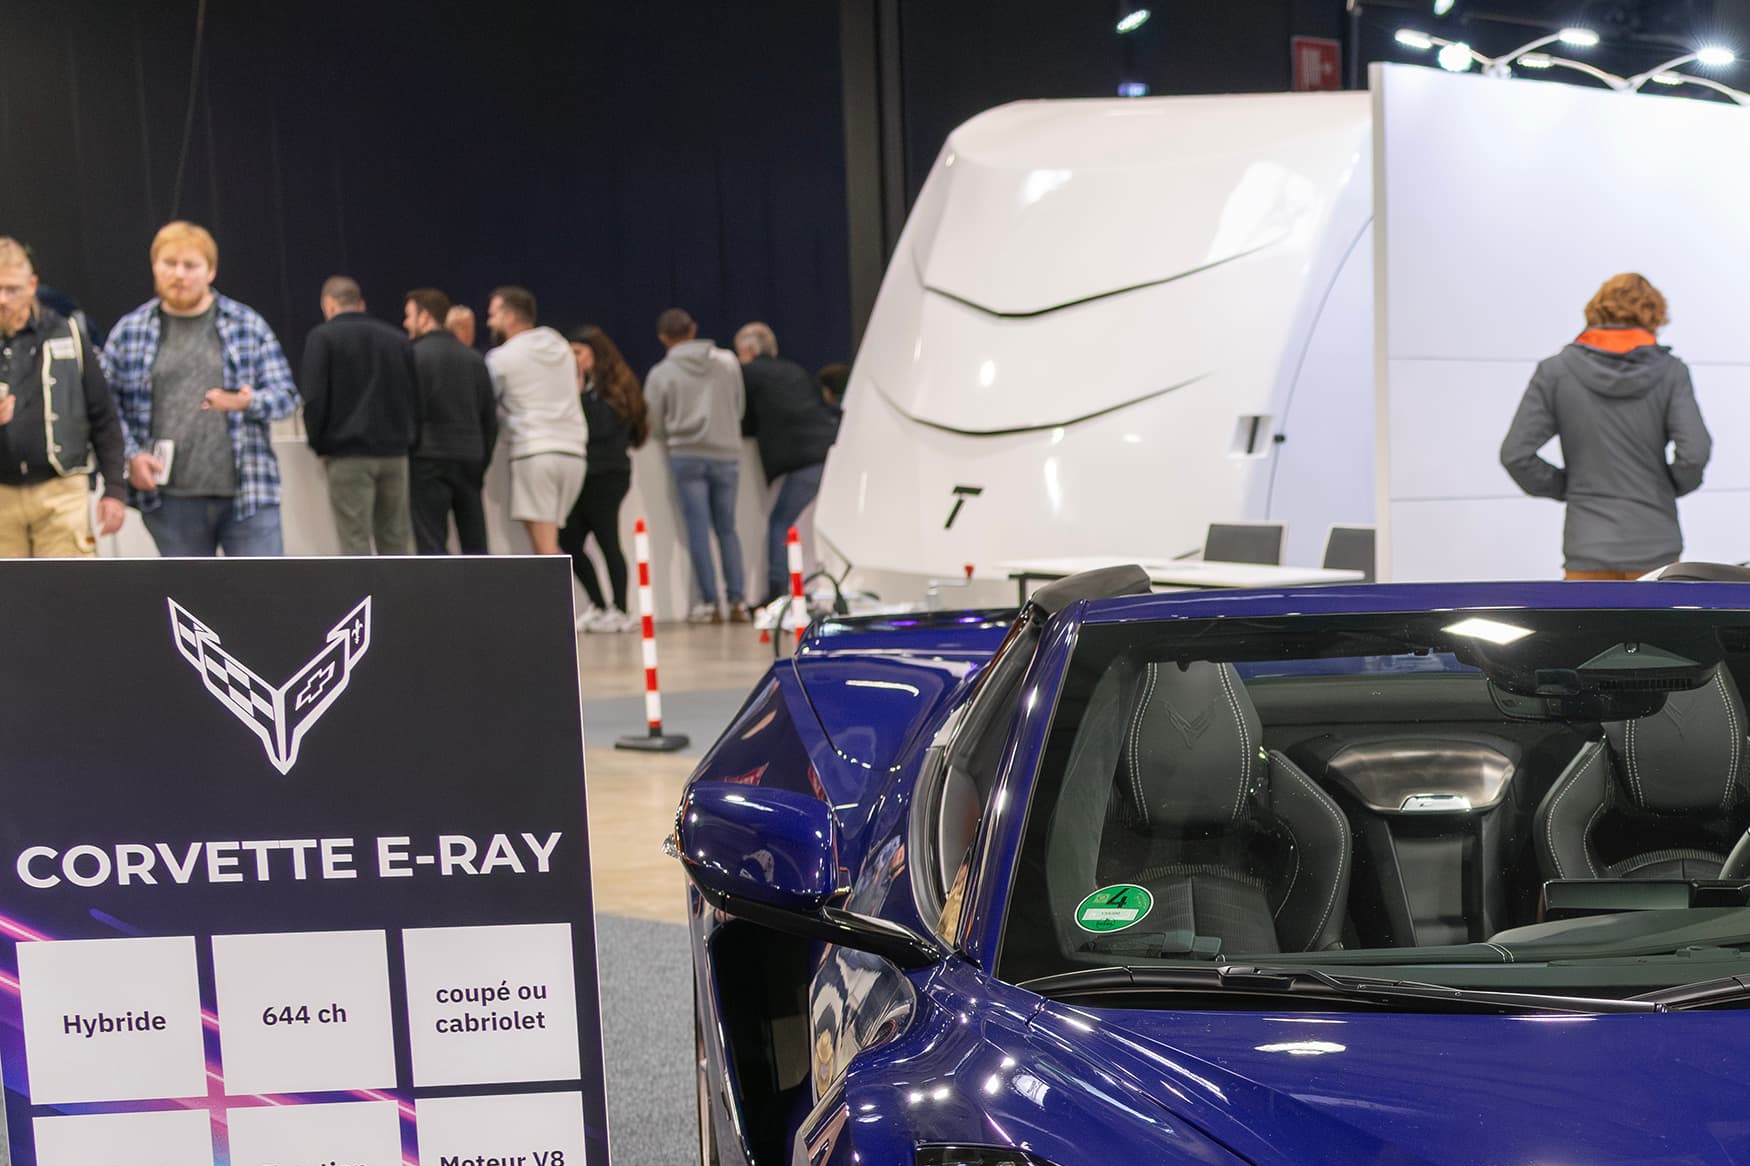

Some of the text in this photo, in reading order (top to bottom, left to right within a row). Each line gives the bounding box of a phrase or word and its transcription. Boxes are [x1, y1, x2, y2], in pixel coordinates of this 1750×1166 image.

[16, 831, 563, 889] CORVETTE E-RAY
[1106, 888, 1131, 909] 4
[436, 980, 547, 1007] coupé ou
[63, 1010, 167, 1039] Hybride
[262, 1003, 347, 1026] 644 ch
[435, 1010, 546, 1034] cabriolet
